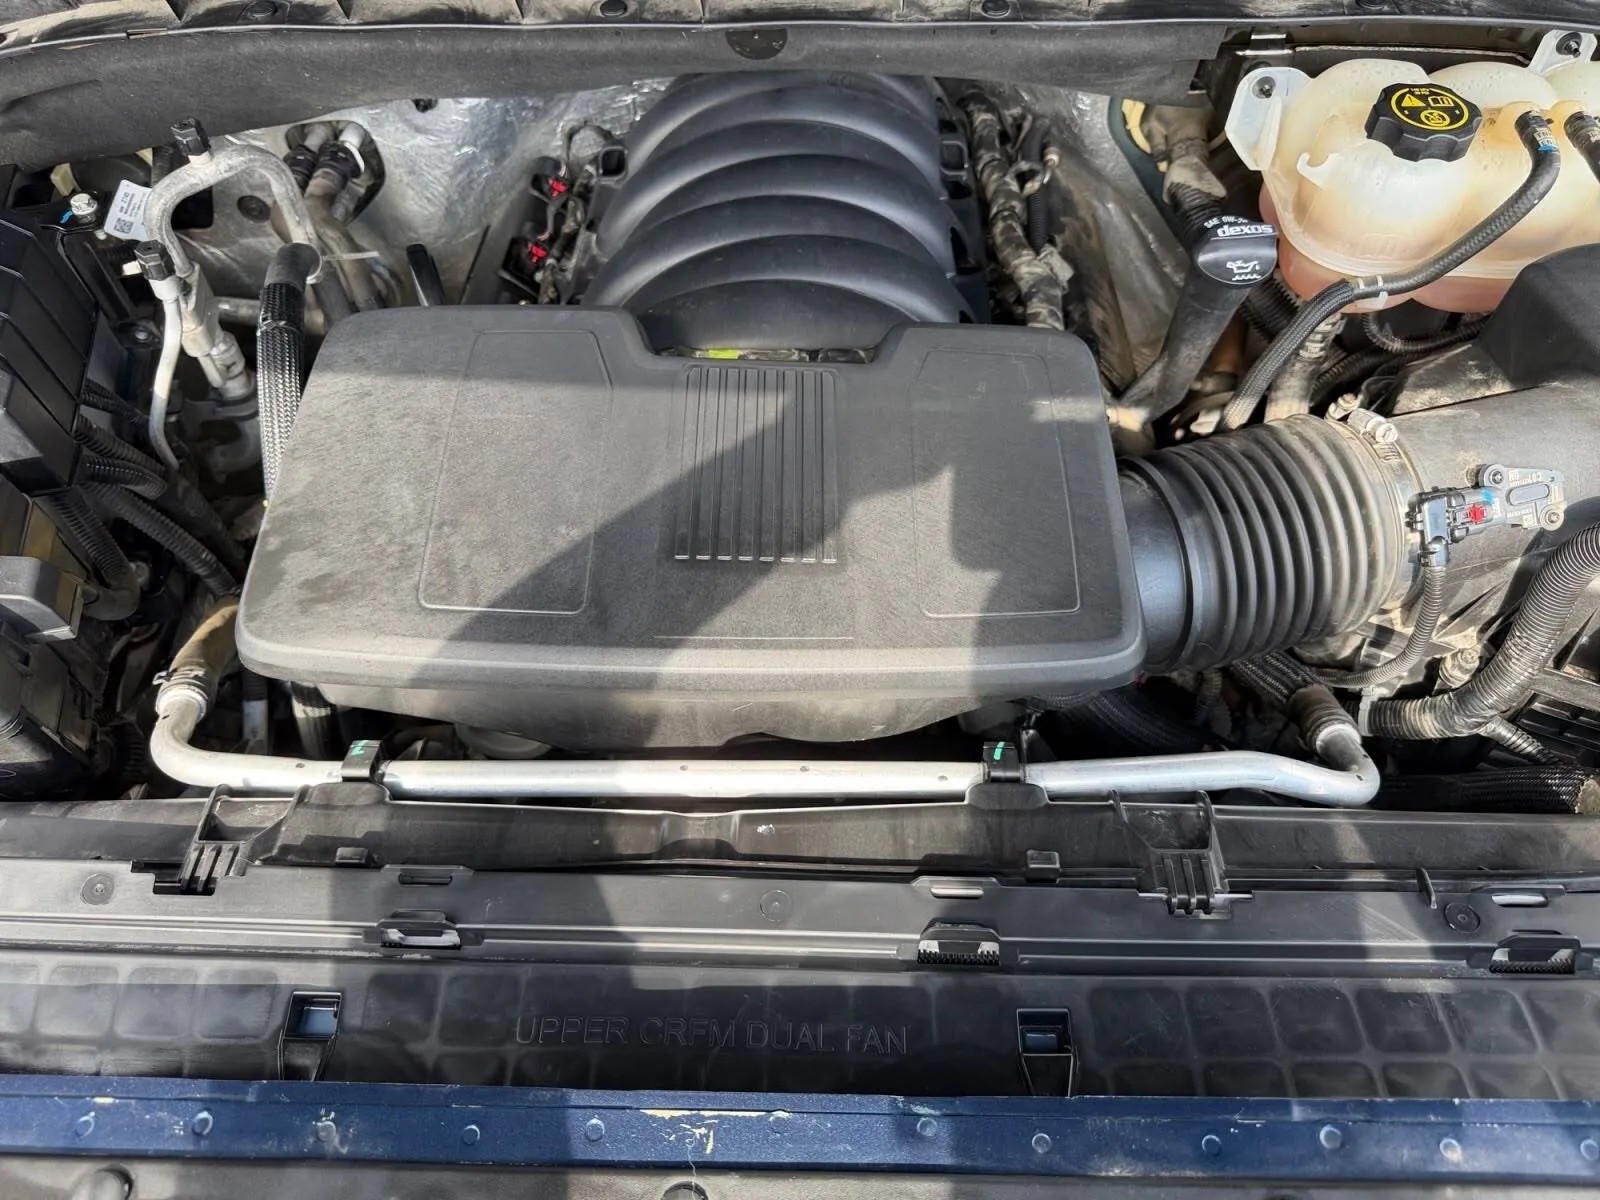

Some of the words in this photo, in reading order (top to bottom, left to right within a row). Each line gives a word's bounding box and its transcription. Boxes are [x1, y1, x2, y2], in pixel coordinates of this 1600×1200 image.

[1217, 225, 1273, 236] dexos
[516, 1015, 629, 1044] UPPER
[639, 1017, 736, 1047] CRFM
[745, 1020, 835, 1052] DUAL
[847, 1024, 908, 1055] FAN
